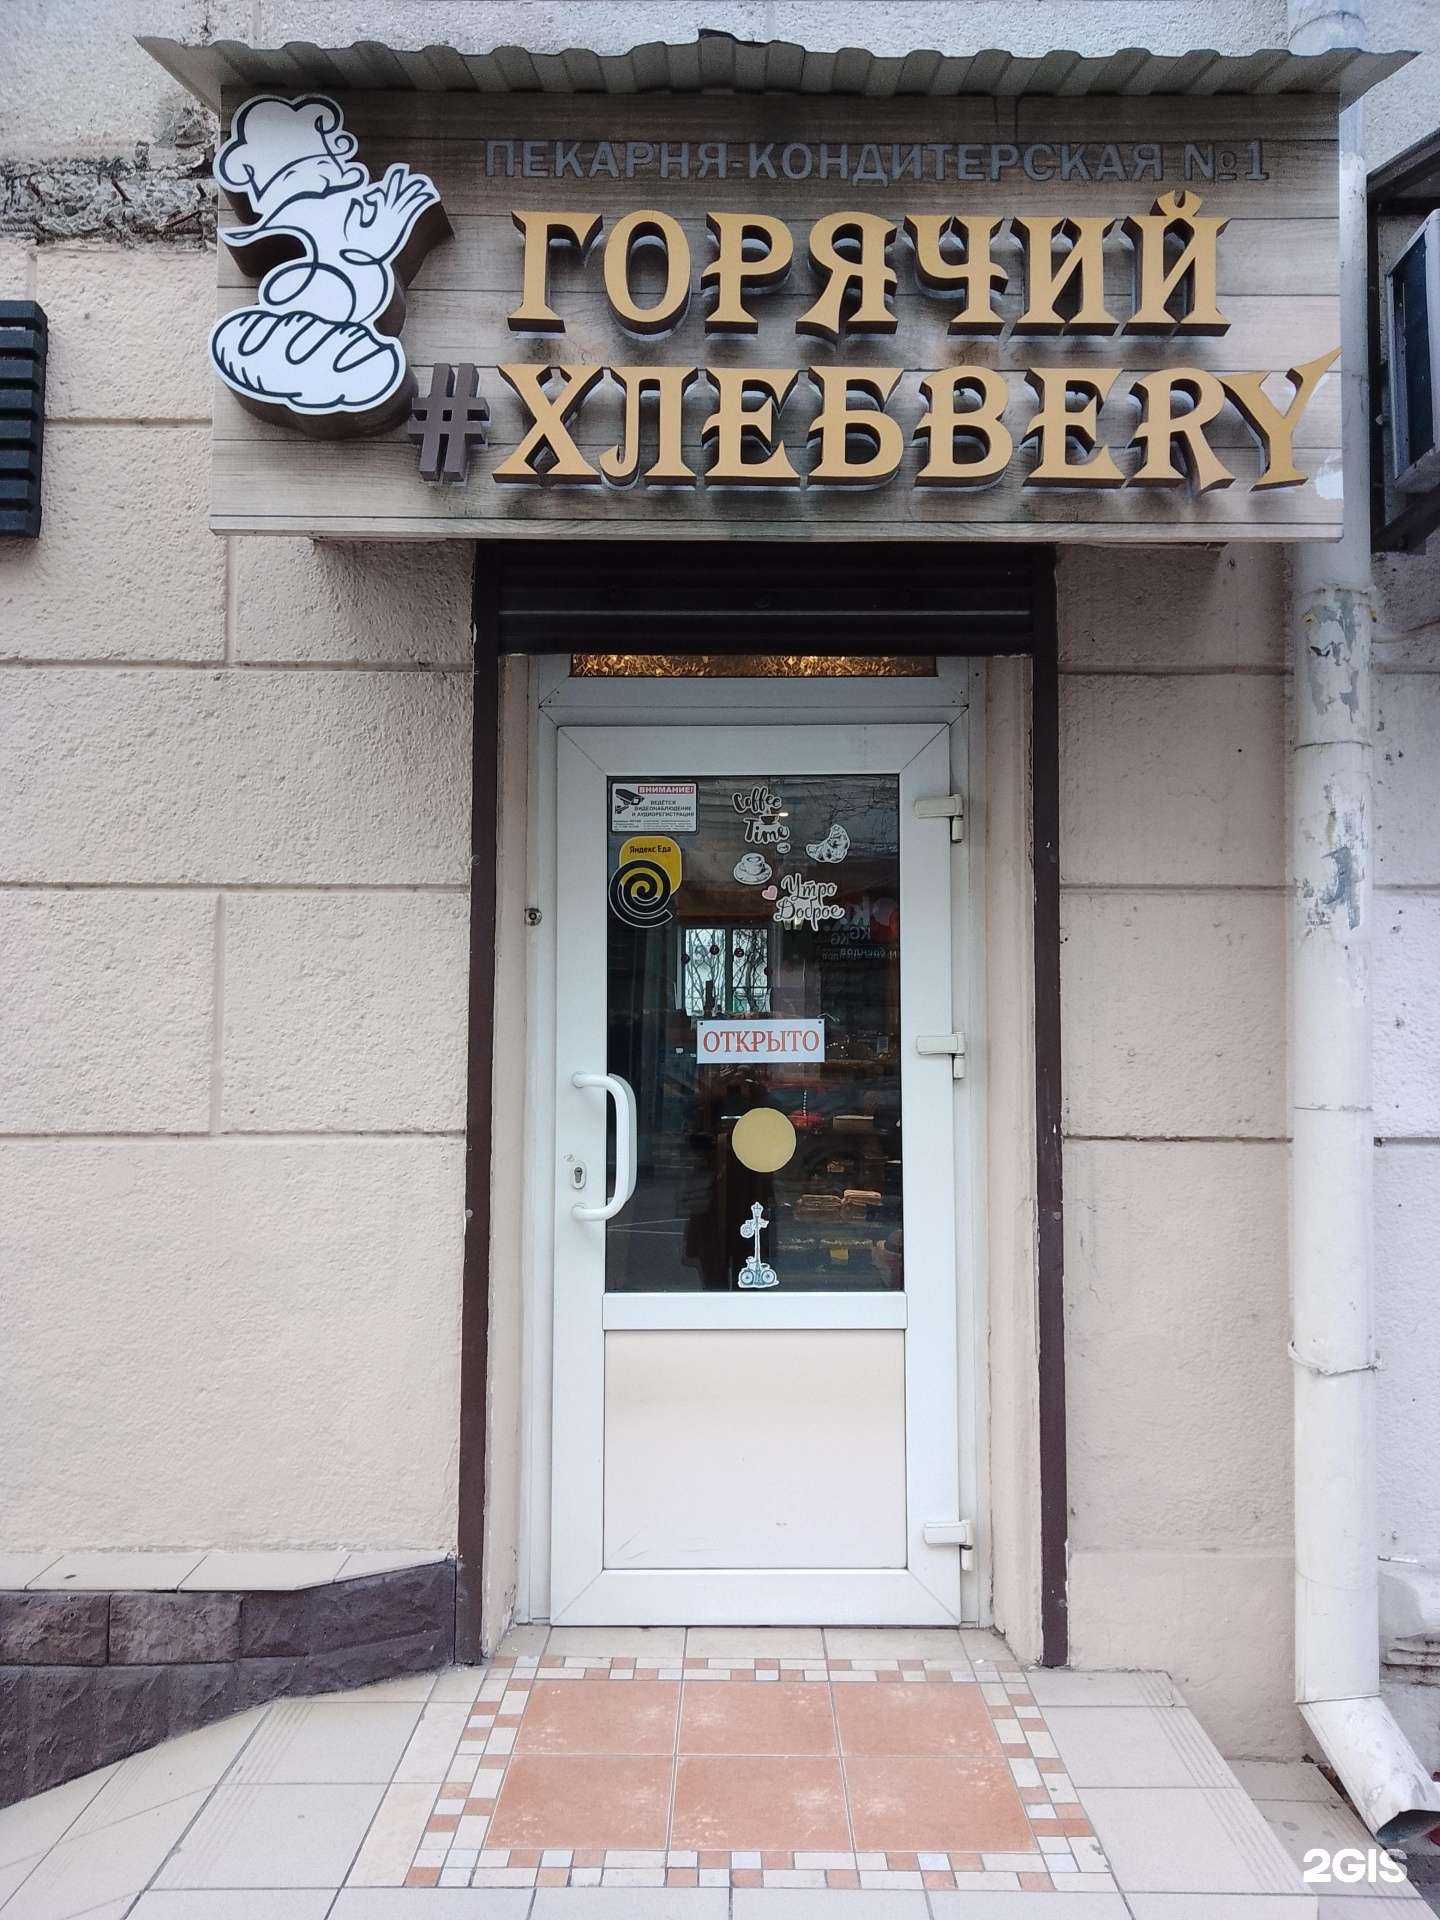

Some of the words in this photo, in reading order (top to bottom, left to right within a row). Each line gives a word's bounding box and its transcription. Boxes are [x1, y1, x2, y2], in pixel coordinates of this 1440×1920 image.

[485, 140, 1163, 188] ПЕКАРНЯ-КОНДИТЕРСКАЯ
[1183, 139, 1269, 182] №1
[508, 190, 1231, 339] ГОРЯЧИЙ
[732, 786, 782, 814] Coffee
[743, 818, 790, 844] Time
[630, 846, 656, 855] Яндекс
[657, 845, 672, 853] Еда
[781, 873, 837, 907] Утро
[773, 896, 846, 931] Доброе
[702, 1030, 820, 1053] ОТКРЫТО
